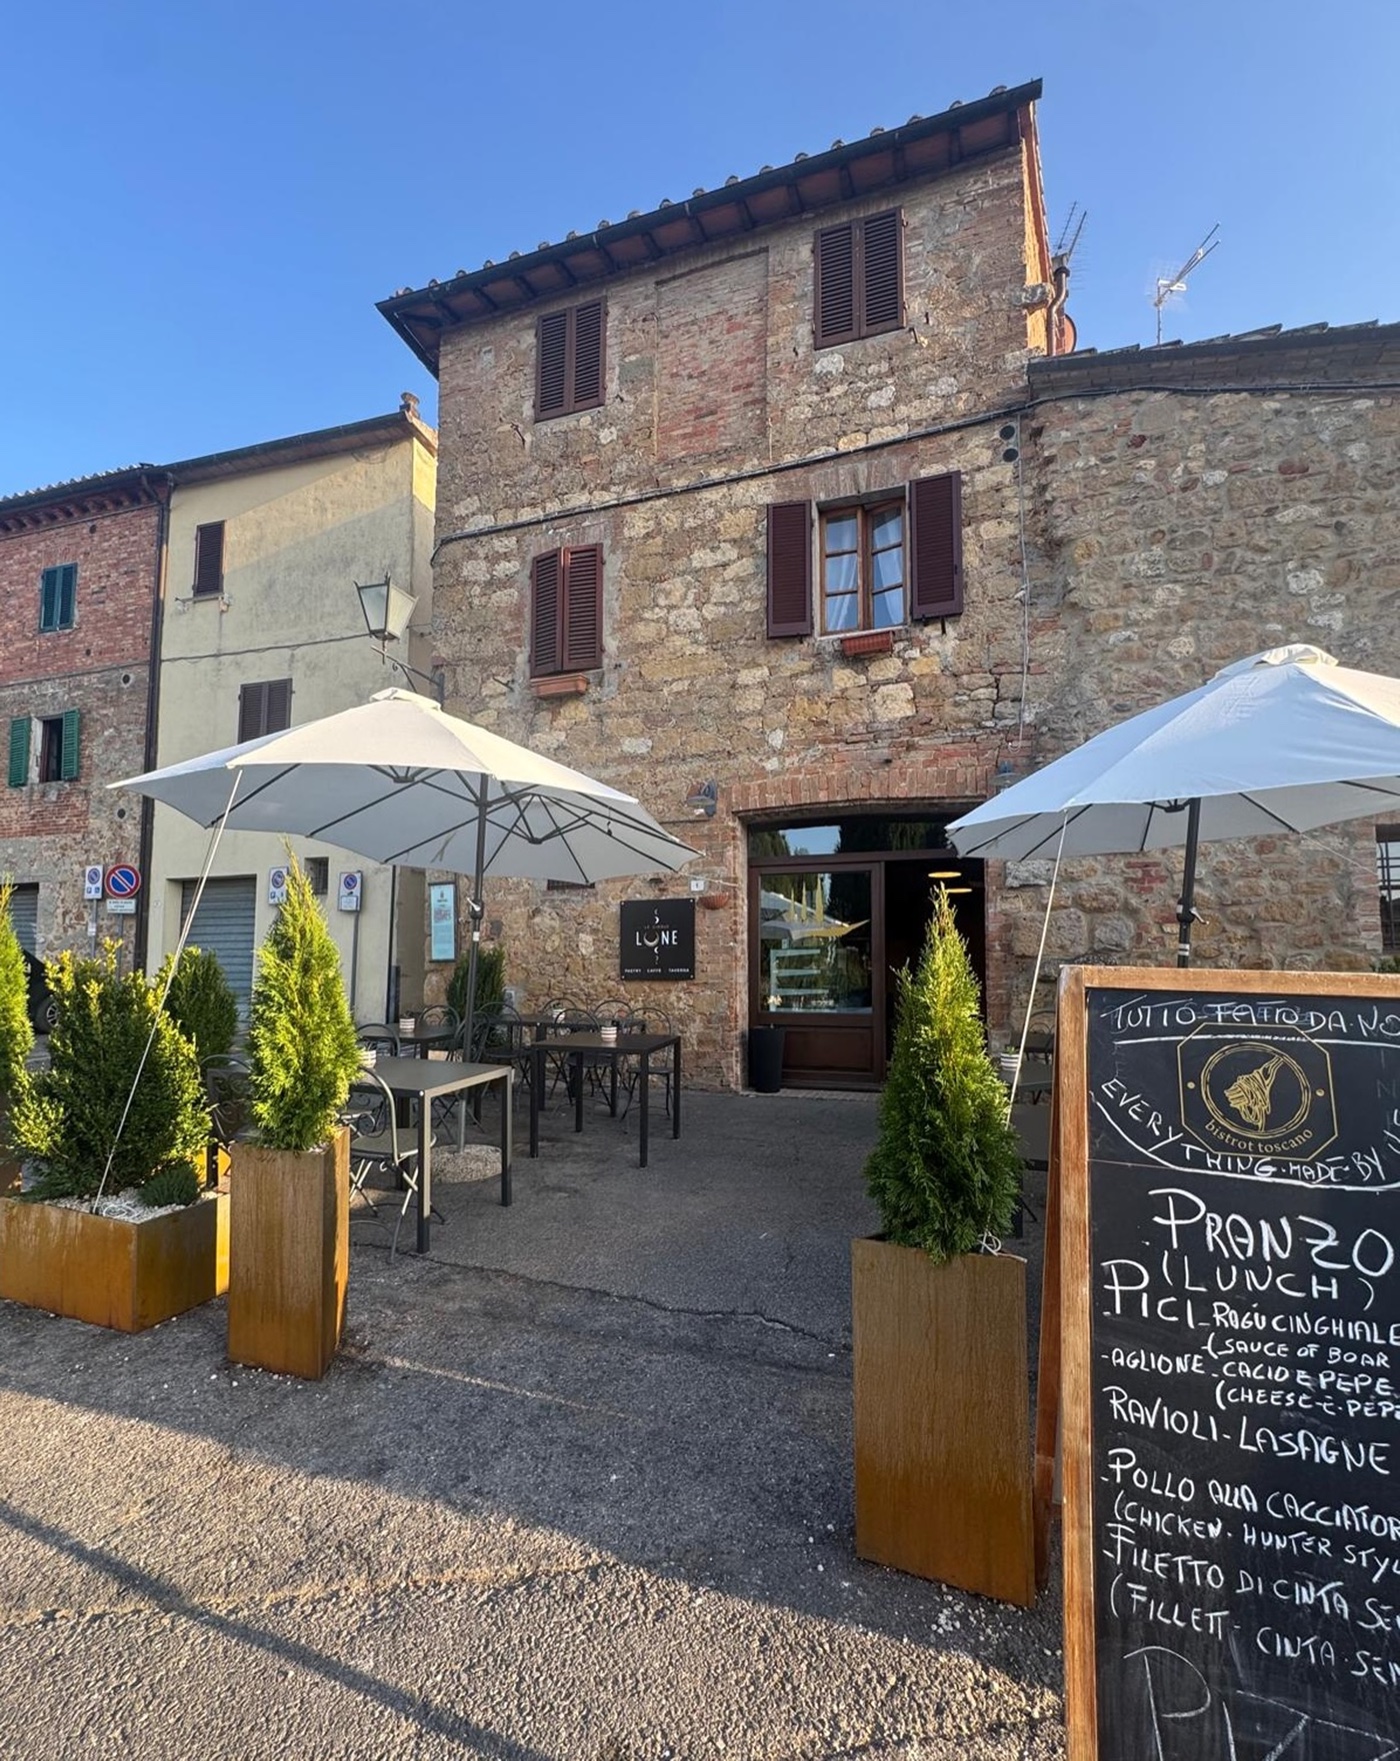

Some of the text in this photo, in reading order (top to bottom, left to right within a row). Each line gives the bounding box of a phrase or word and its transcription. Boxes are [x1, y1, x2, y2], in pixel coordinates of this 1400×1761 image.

[1205, 1119, 1313, 1153] bistrot toscano
[1351, 1146, 1386, 1182] BY
[1148, 1188, 1395, 1277] PRANZO
[1296, 1344, 1320, 1358] OF
[1327, 1347, 1390, 1368] BOAR
[1319, 1370, 1394, 1396] PEPE
[1239, 1416, 1391, 1475] LASAGNE
[1208, 1479, 1258, 1512] ALLA
[1243, 1523, 1332, 1557] HUNTER
[1236, 1570, 1263, 1595] DI
[1273, 1581, 1350, 1620] CINTA
[1257, 1627, 1335, 1666] CINTA
